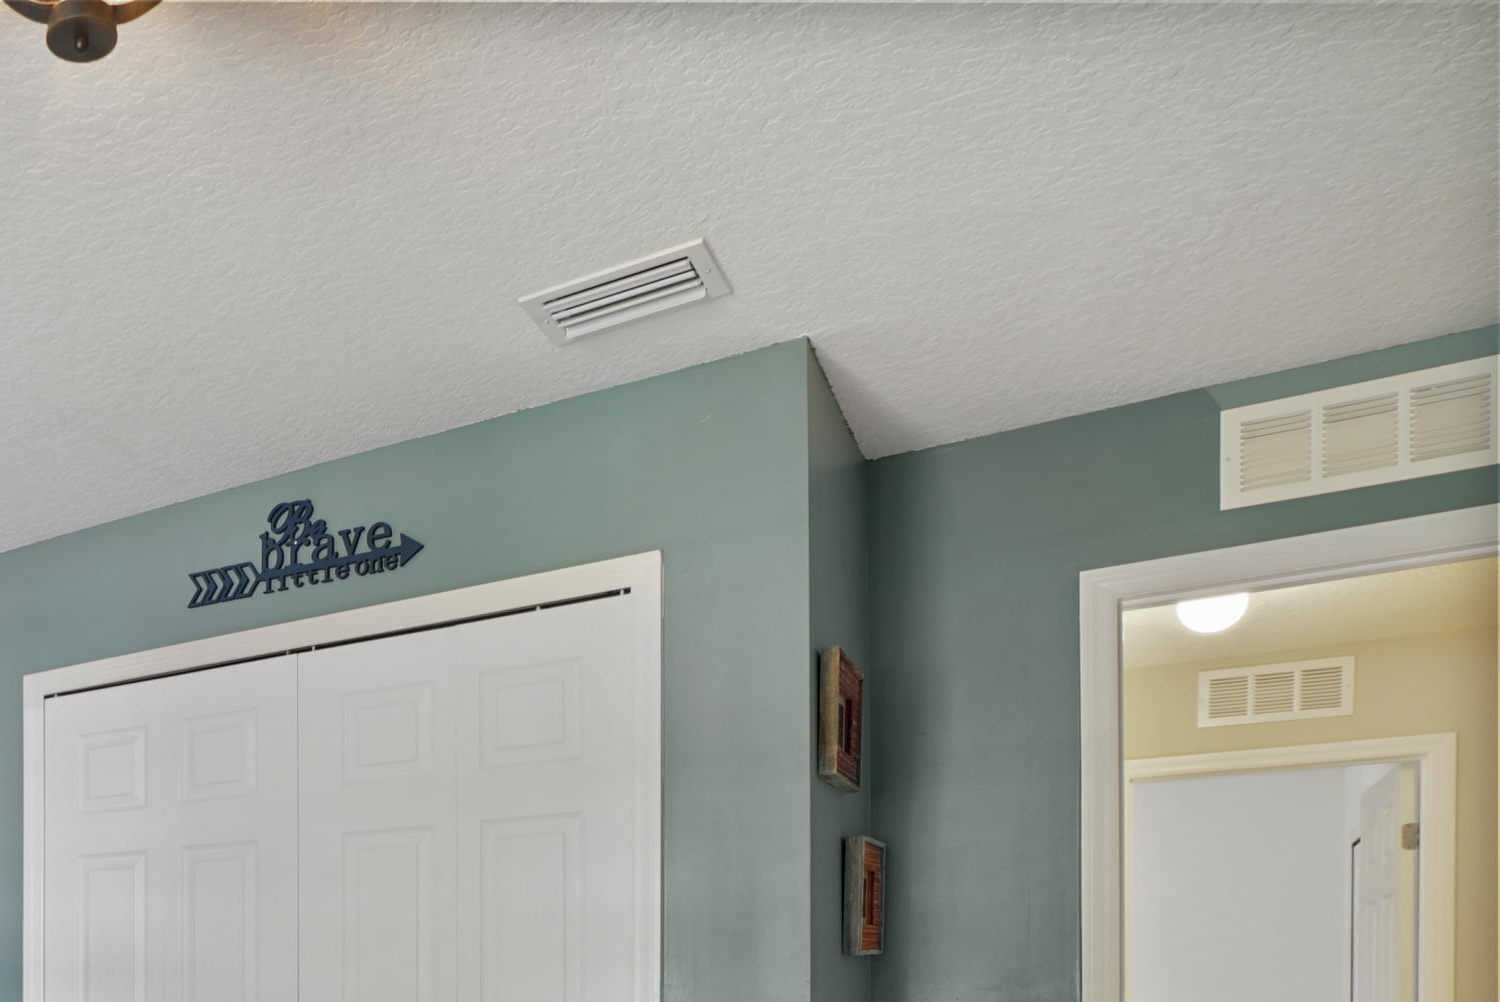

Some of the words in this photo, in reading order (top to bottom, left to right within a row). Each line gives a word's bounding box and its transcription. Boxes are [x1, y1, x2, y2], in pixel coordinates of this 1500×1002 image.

[260, 521, 393, 574] brave
[268, 499, 327, 548] Be
[263, 565, 350, 594] little
[355, 553, 400, 576] one
